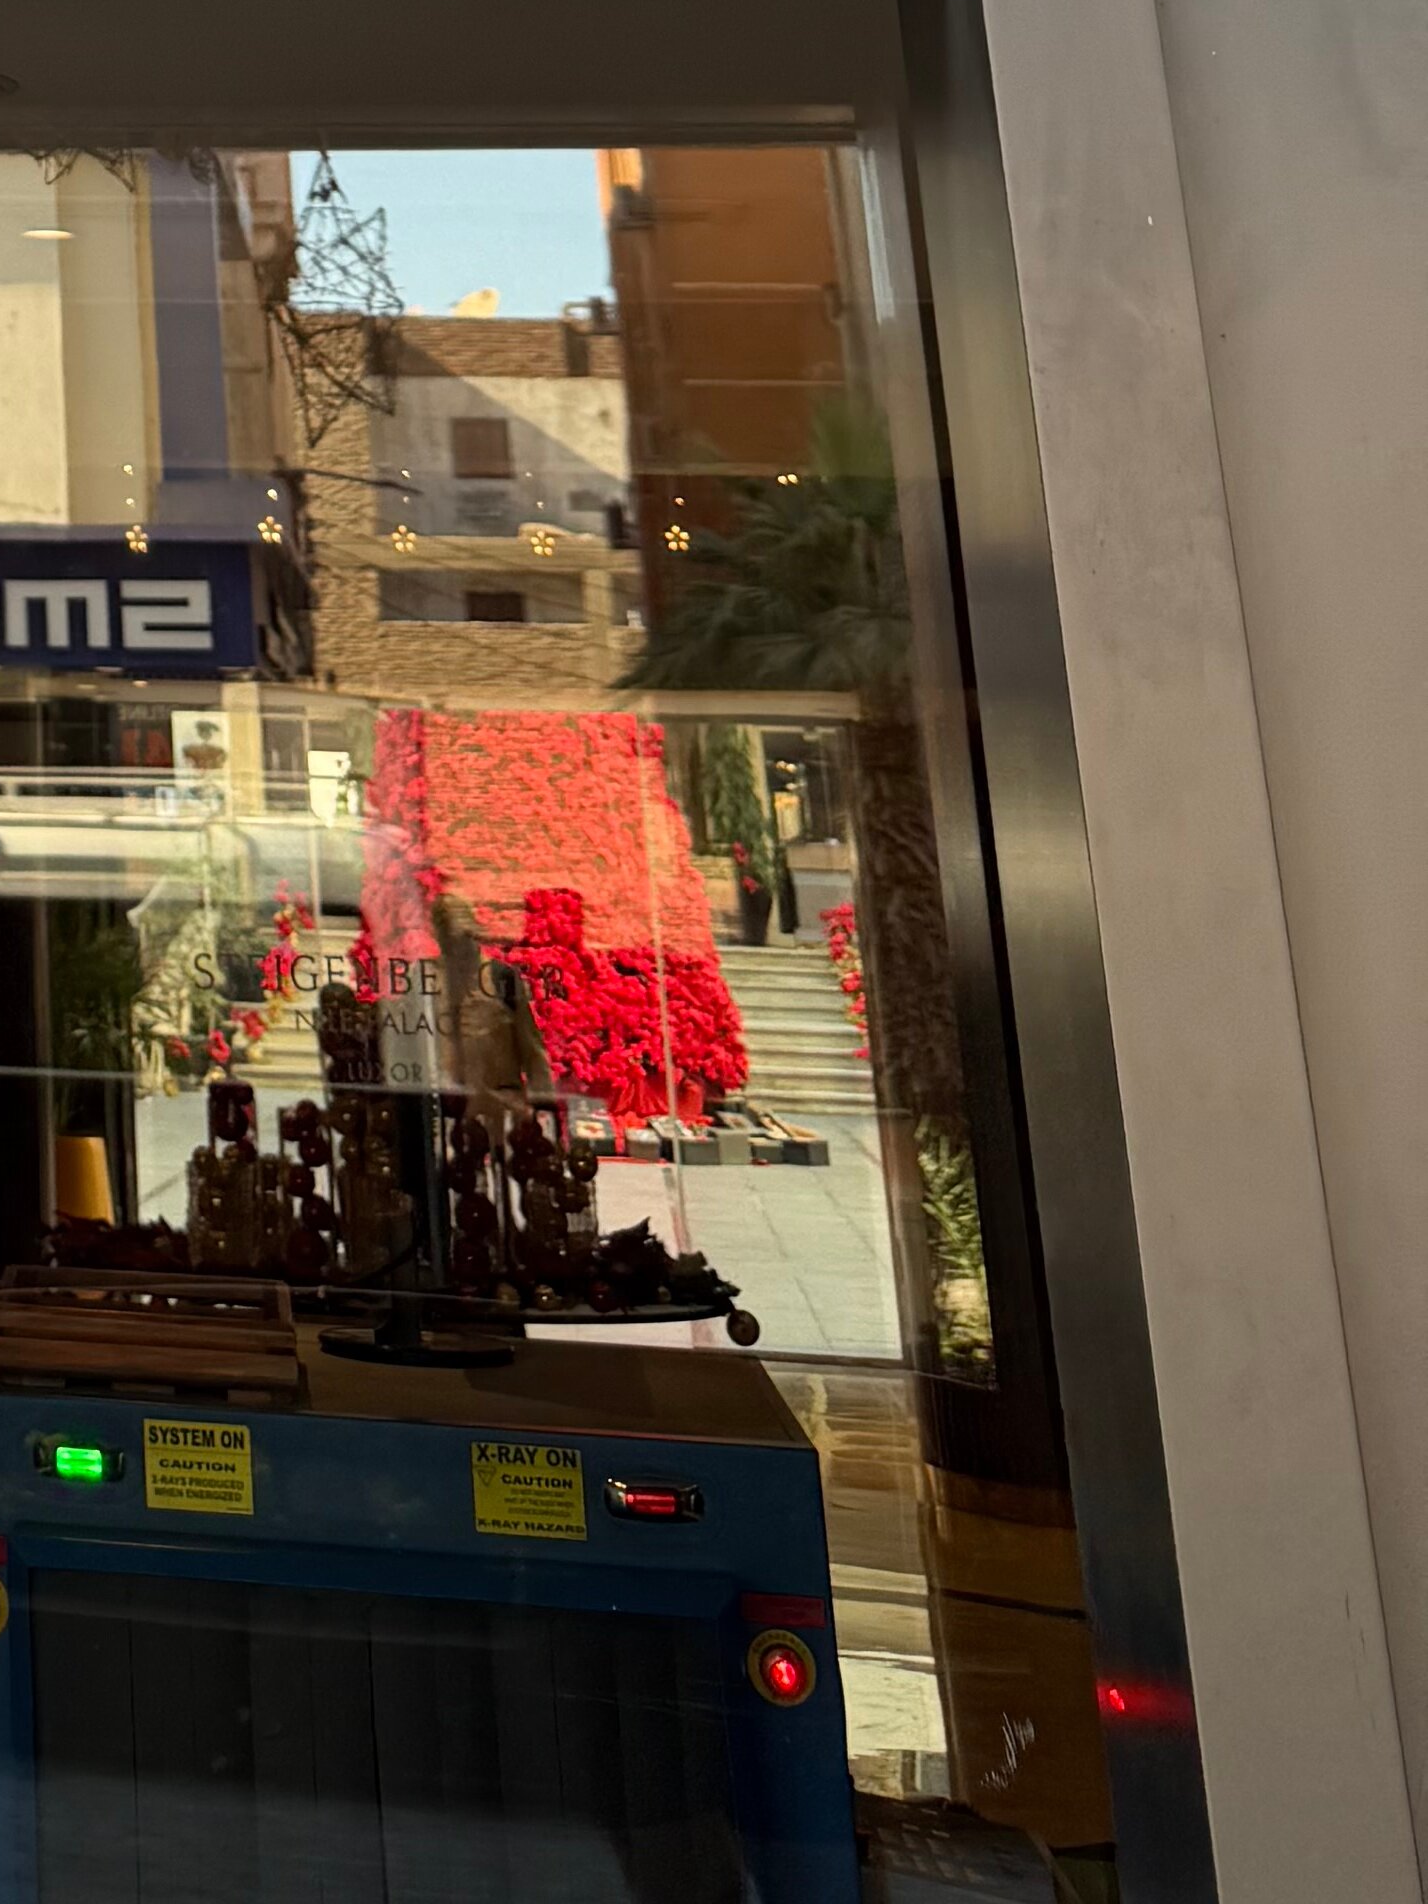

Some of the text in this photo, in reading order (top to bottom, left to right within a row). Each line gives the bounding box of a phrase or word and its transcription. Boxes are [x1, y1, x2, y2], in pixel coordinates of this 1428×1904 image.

[194, 952, 569, 1001] SIGENBEGR
[149, 1425, 245, 1450] SYSTEM ON
[477, 1444, 577, 1468] X-RAY ON
[159, 1459, 237, 1473] CAUTION
[501, 1474, 574, 1489] CAUTION
[525, 1521, 586, 1533] HAZARD
